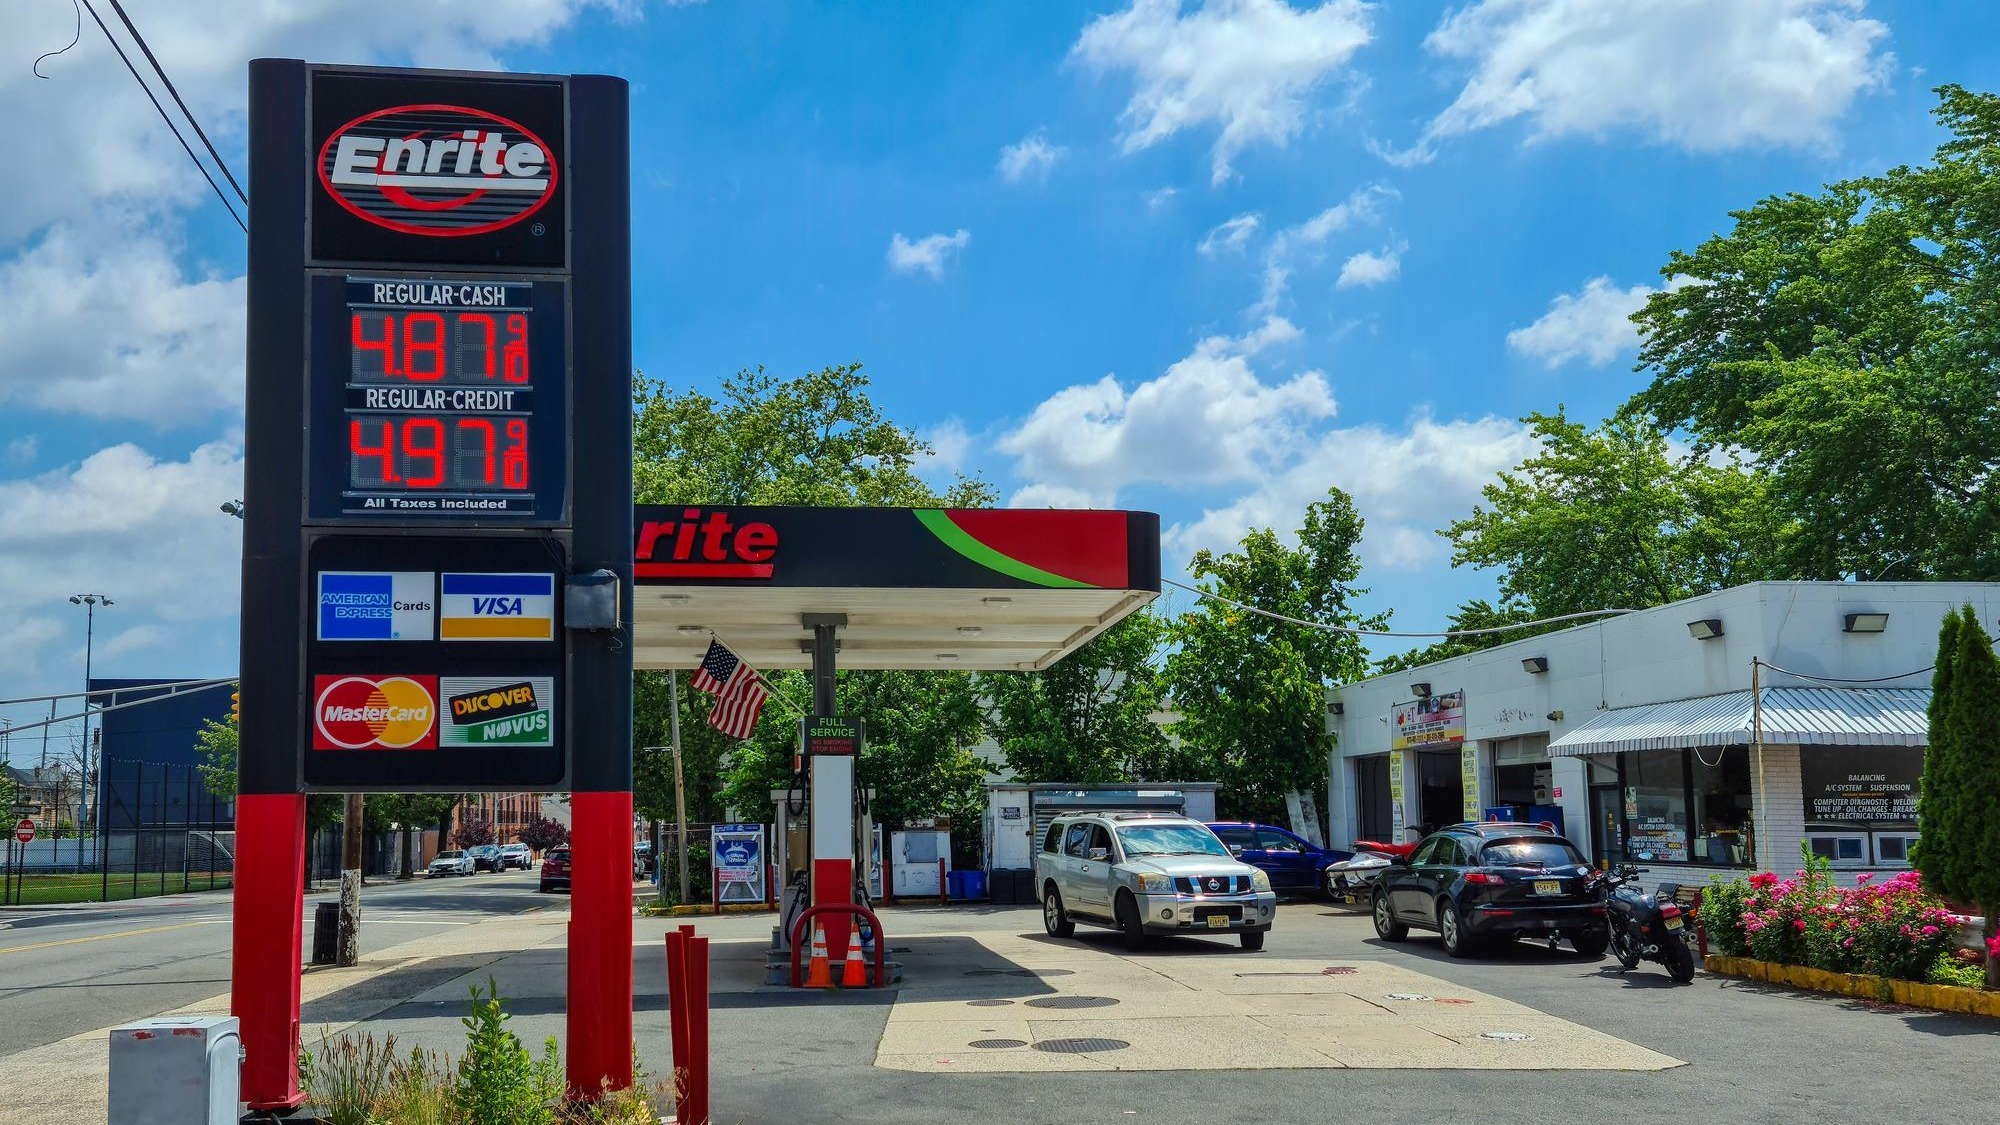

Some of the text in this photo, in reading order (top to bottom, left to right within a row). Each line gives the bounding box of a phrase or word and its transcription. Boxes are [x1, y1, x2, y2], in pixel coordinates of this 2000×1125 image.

[331, 130, 546, 186] Enrite
[373, 283, 506, 306] REGULAR-CASH
[352, 313, 496, 380] 4.87
[365, 389, 515, 411] REGULAR-CREDIT
[351, 418, 496, 488] 4.97
[364, 498, 508, 509] All Taxes included
[321, 593, 389, 605] AMERICAN
[393, 601, 431, 611] Cards
[472, 597, 522, 615] VISA
[335, 607, 393, 618] EXPRESS
[453, 686, 534, 716] DISCOVER
[324, 706, 428, 722] MasterCard
[819, 717, 846, 726] FULL
[810, 728, 855, 737] SERVICE
